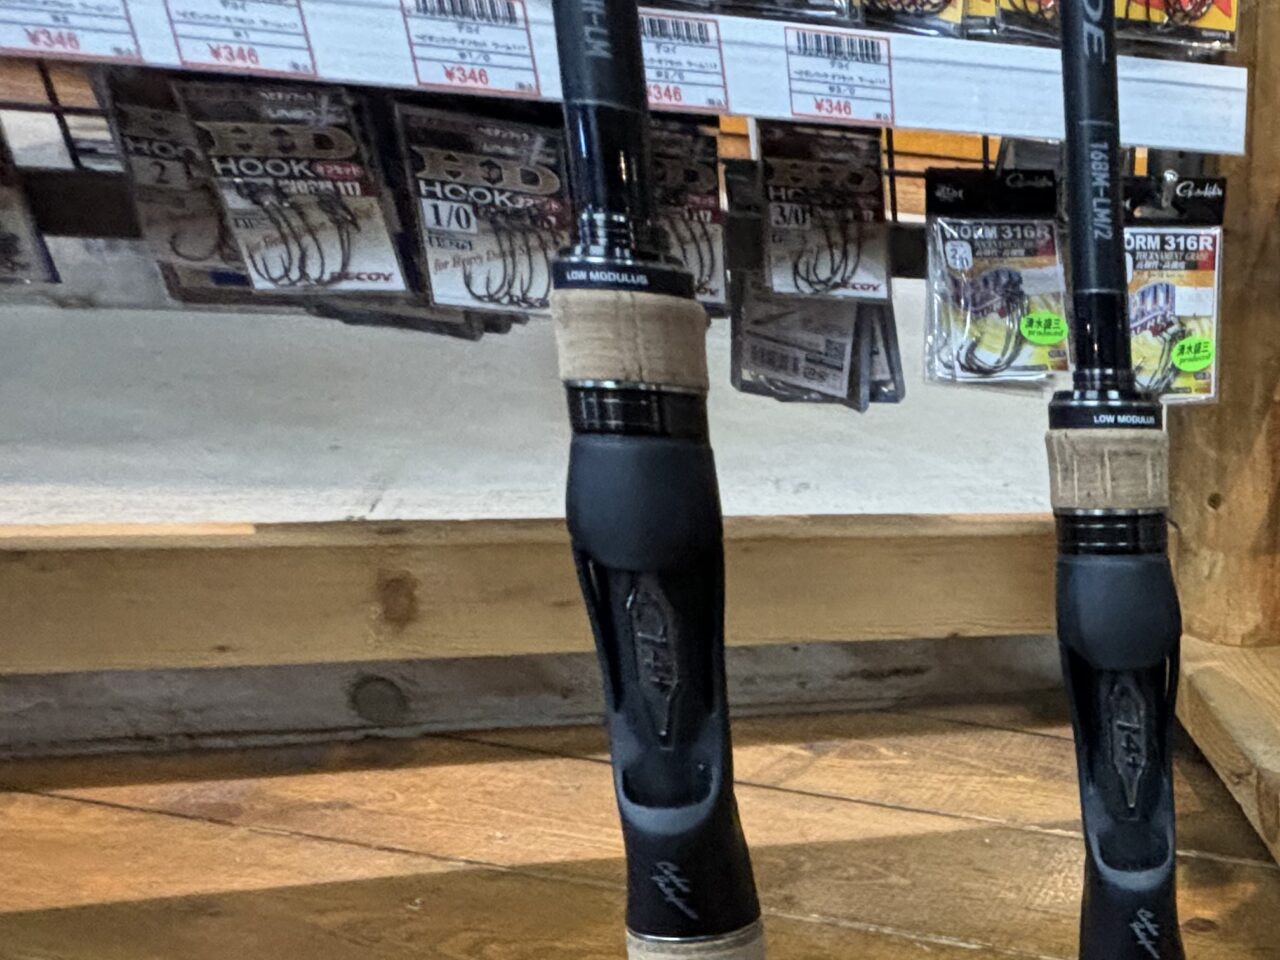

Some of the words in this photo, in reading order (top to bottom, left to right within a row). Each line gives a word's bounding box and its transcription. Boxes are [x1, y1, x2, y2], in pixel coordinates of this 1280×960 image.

[24, 26, 81, 50] ¥346
[207, 42, 260, 65] ¥346
[442, 63, 489, 85] ¥346
[813, 95, 852, 115] ¥346
[211, 156, 315, 178] HOOK
[418, 180, 512, 209] HOOK
[431, 203, 472, 230] 1/0
[1125, 234, 1160, 250] ORM
[1165, 234, 1214, 251] 316R
[566, 270, 588, 283] LOW
[589, 271, 649, 286] MODULUS
[1093, 414, 1115, 424] LOW
